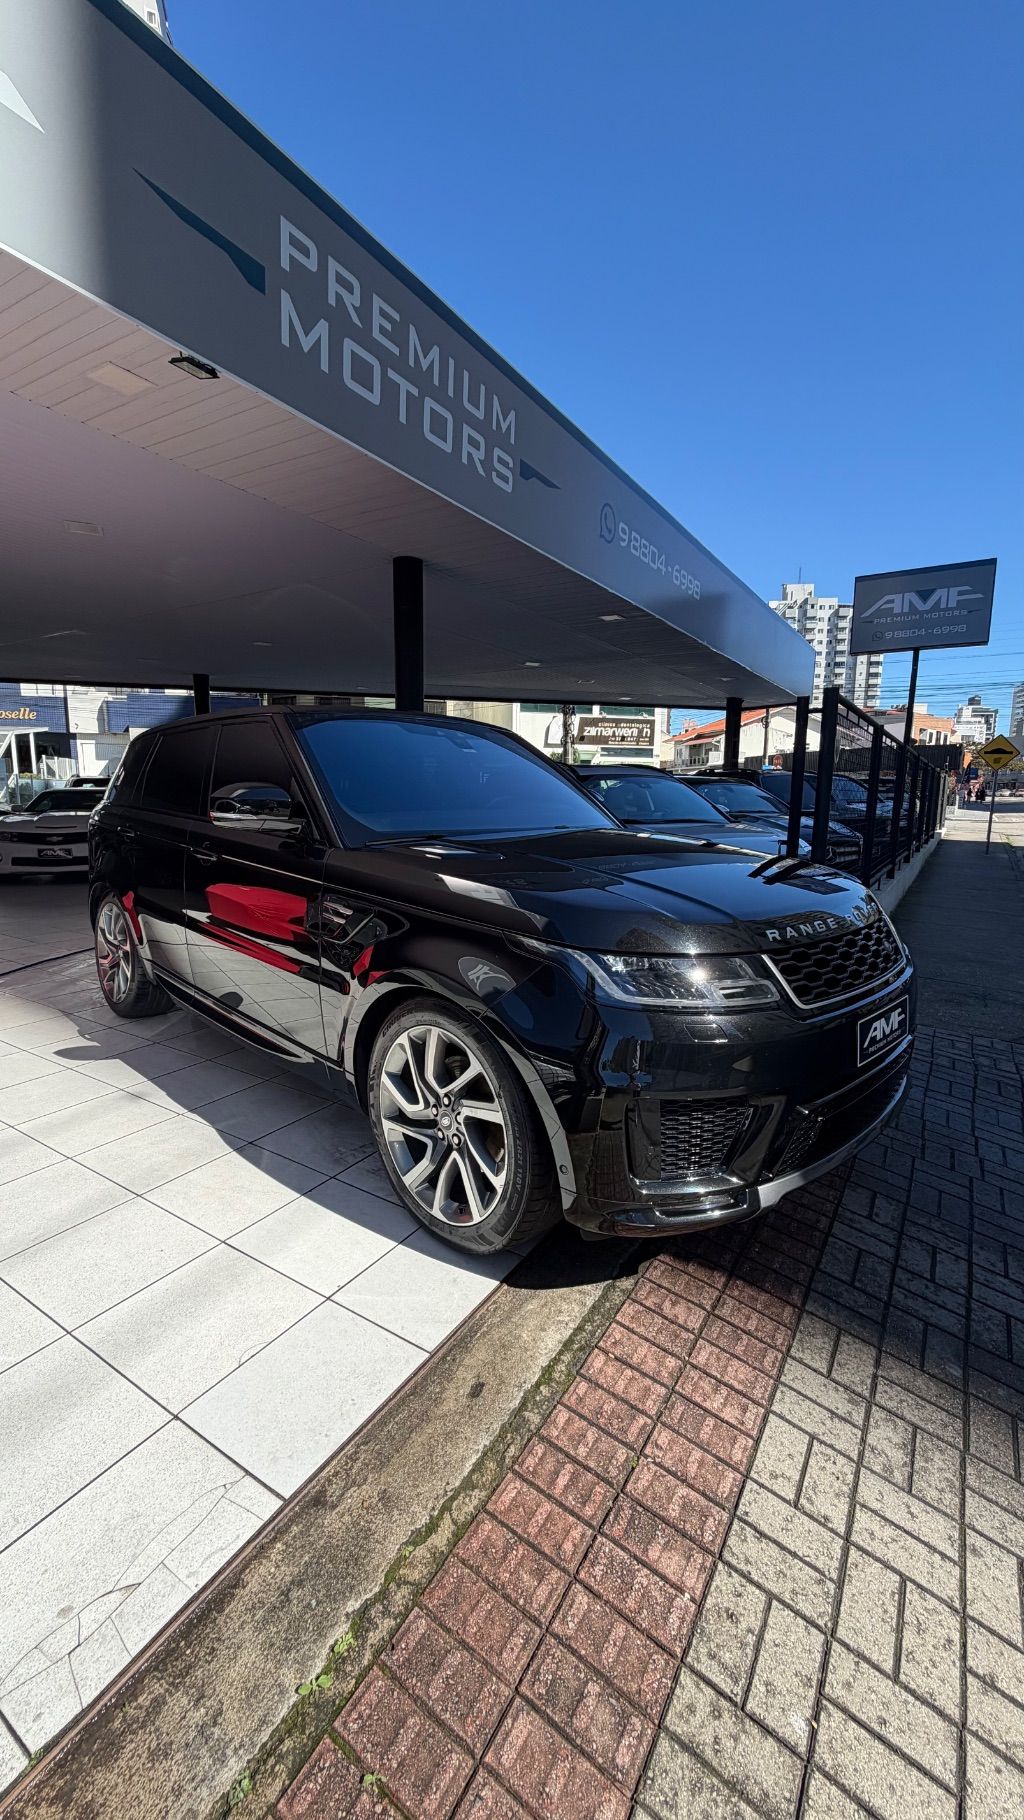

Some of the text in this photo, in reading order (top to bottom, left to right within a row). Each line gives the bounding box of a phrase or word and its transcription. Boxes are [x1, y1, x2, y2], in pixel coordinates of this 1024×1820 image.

[280, 215, 516, 445] PREMIUM
[280, 288, 514, 493] MOTORS
[860, 585, 985, 618] AMF
[873, 609, 968, 625] PREMIUM MOTORS
[765, 917, 839, 942] RANGE
[863, 1007, 906, 1049] AMF
